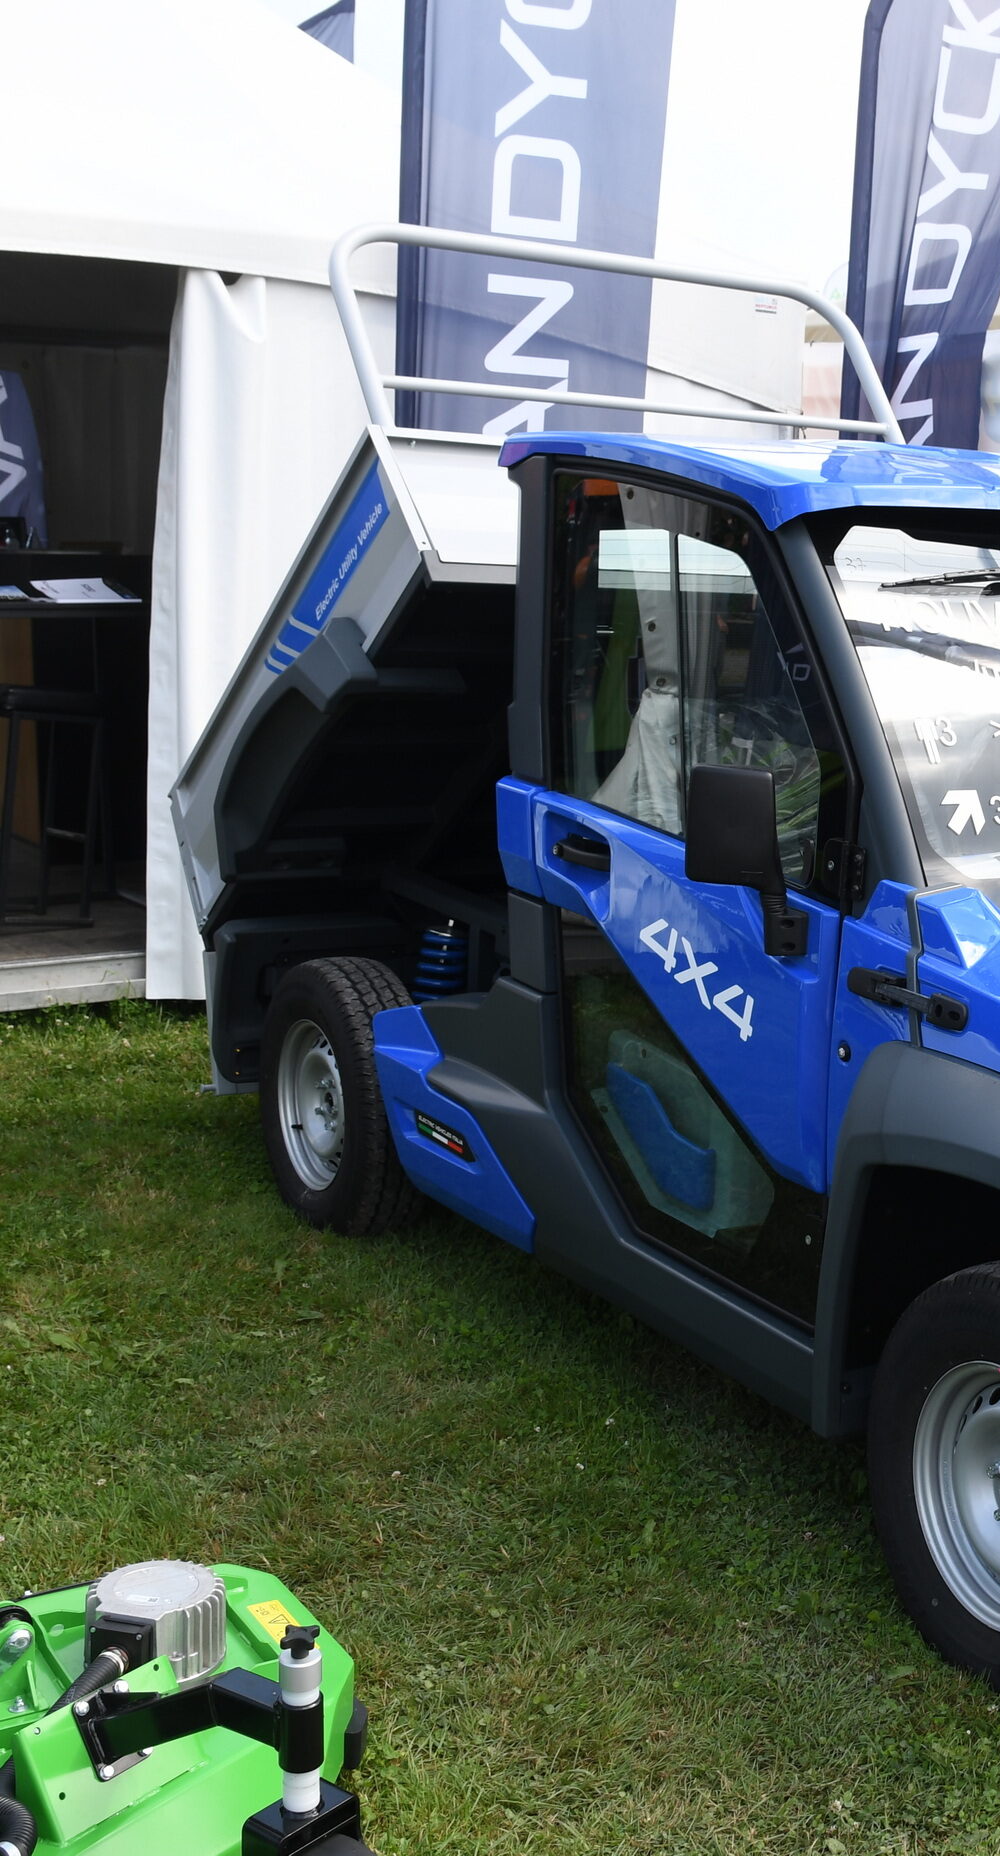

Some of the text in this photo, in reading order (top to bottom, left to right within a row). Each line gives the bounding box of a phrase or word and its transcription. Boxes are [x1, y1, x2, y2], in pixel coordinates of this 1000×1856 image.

[315, 503, 383, 621] Electric Utility Vehicle
[639, 918, 755, 1042] 4X4
